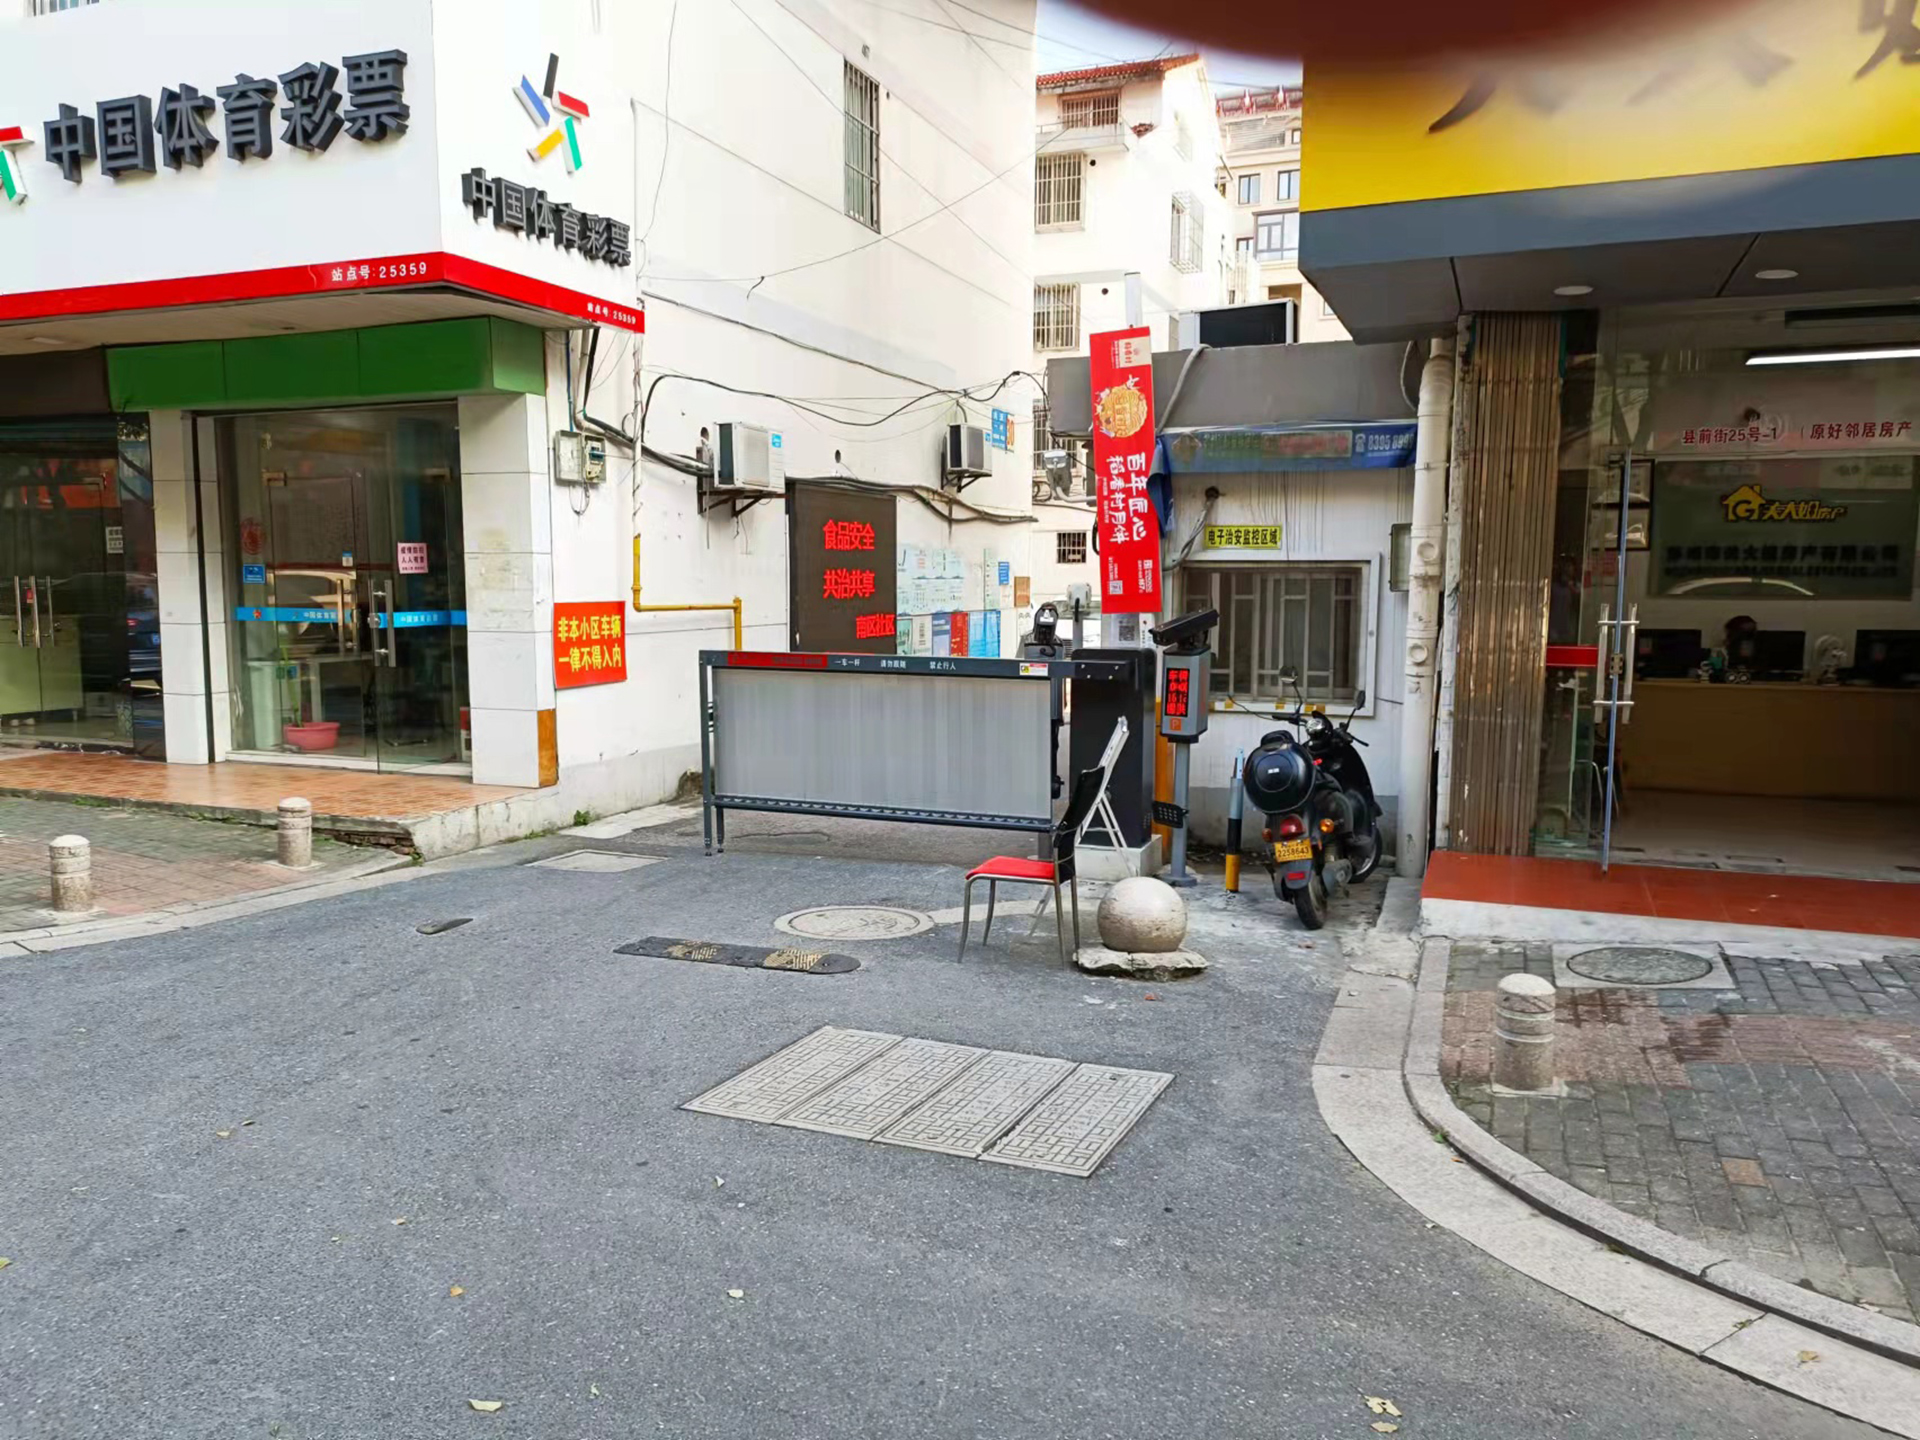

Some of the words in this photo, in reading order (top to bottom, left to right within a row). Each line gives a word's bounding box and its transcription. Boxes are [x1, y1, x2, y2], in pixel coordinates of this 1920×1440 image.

[44, 49, 411, 183] 中国体育彩票
[461, 167, 631, 267] 中国体育彩票
[1106, 455, 1130, 544] 稻香村月饼
[1126, 452, 1149, 541] 百年匠心
[823, 519, 875, 550] 食品安全
[1208, 529, 1278, 545] 电子治安监控区域
[823, 568, 875, 599] 共治共享
[558, 614, 621, 642] 非本小区车辆
[856, 613, 895, 639] 南区社区
[559, 643, 621, 672] 一律不得入内
[930, 661, 956, 670] 禁止行人
